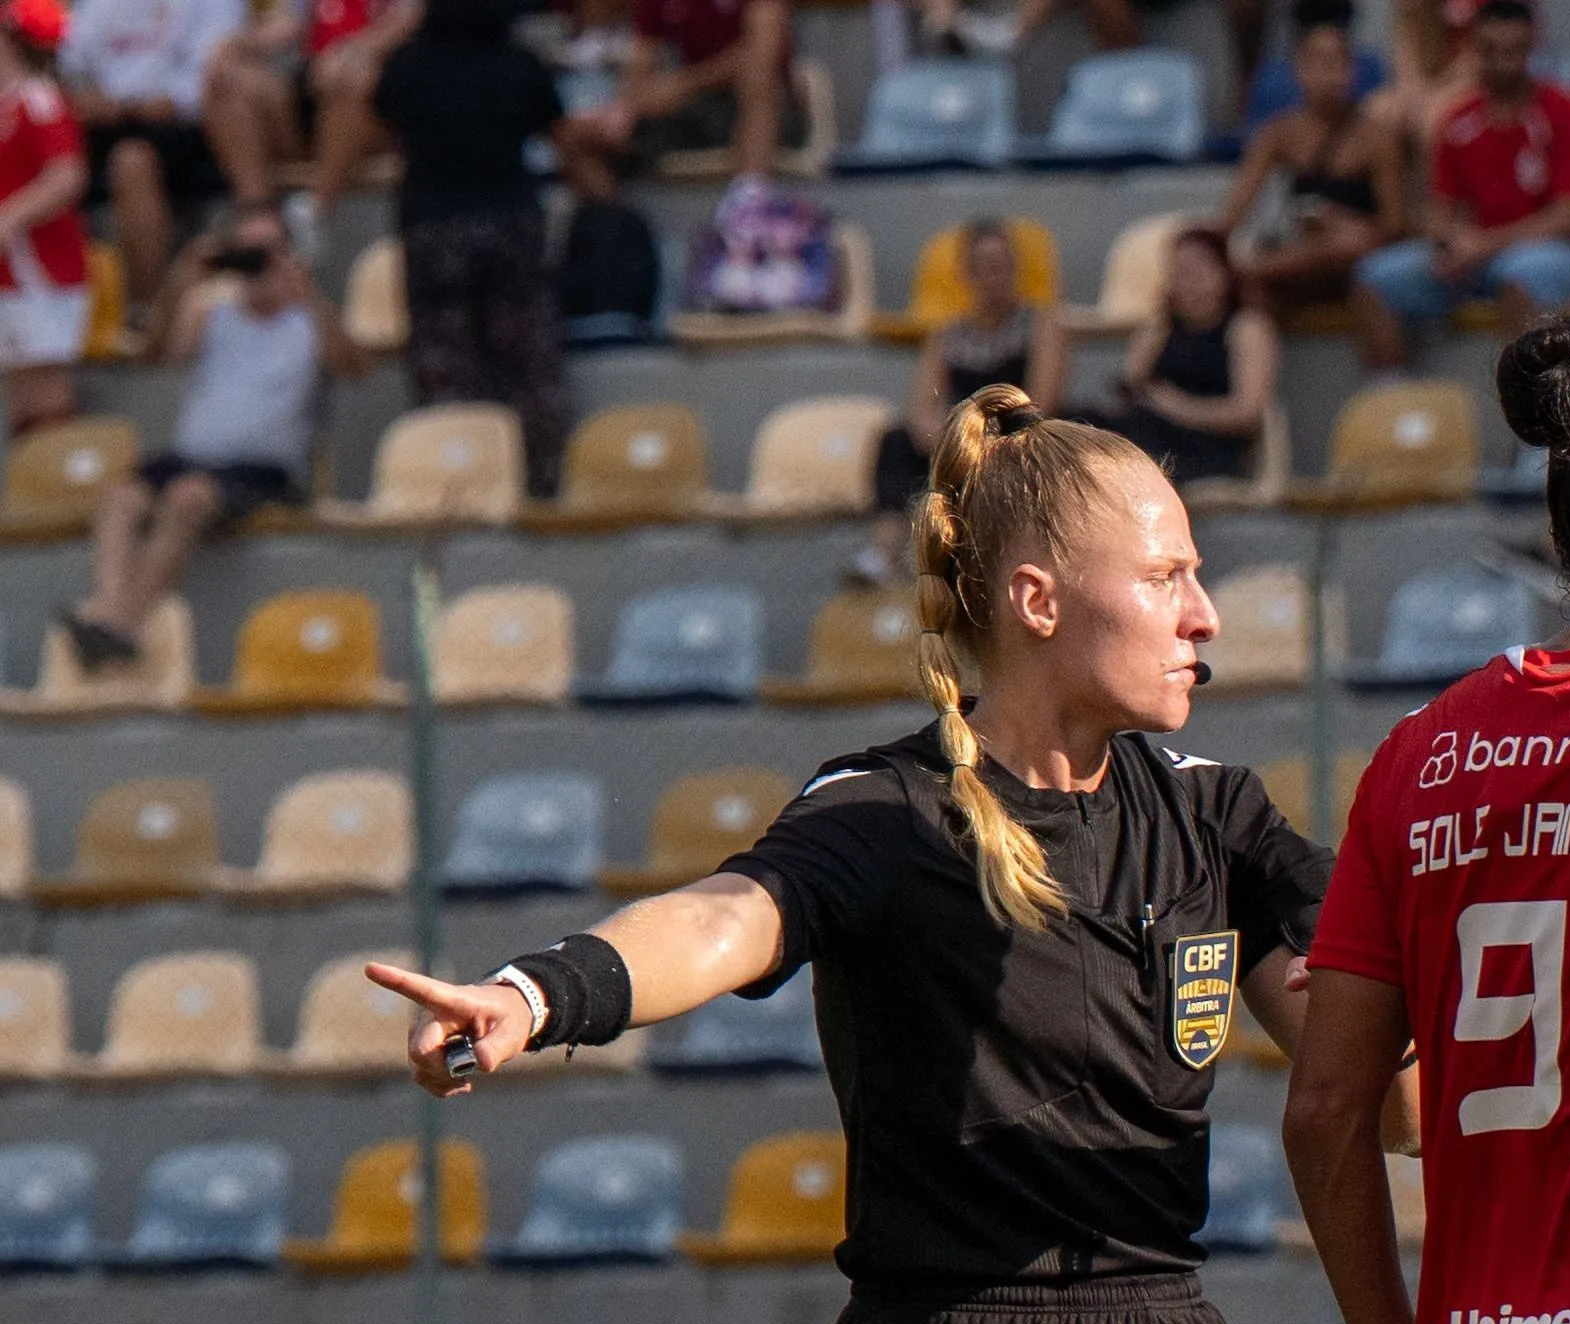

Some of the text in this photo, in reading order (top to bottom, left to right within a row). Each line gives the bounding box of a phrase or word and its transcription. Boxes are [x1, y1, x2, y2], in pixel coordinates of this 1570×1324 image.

[1409, 805, 1491, 877] SOLE
[1184, 943, 1227, 973] CBF
[1186, 999, 1220, 1015] ÁRBITRA
[1453, 900, 1567, 1136] 9
